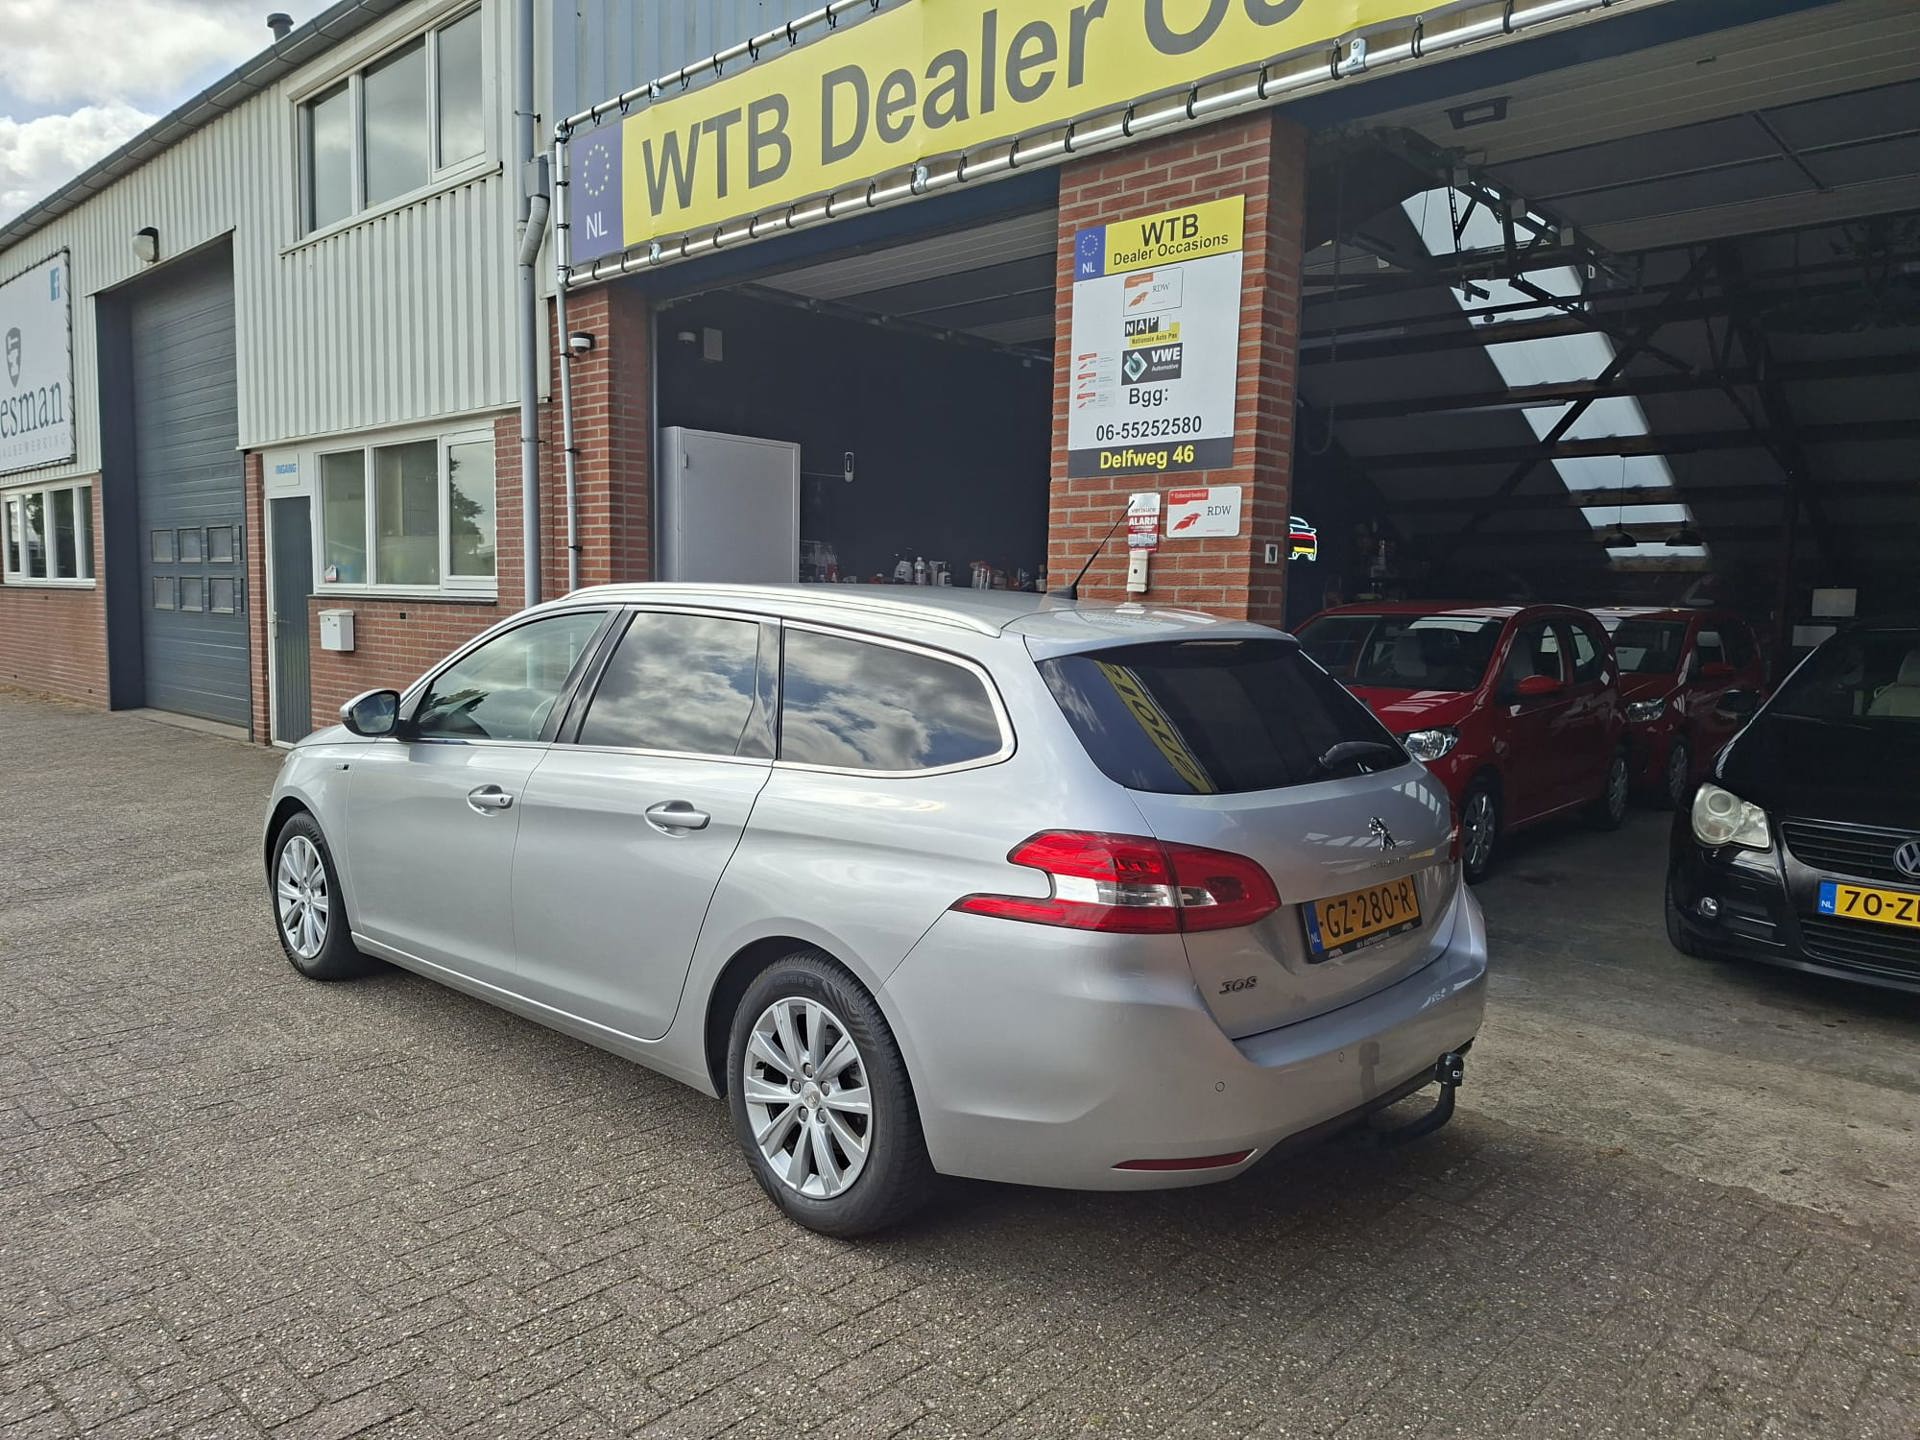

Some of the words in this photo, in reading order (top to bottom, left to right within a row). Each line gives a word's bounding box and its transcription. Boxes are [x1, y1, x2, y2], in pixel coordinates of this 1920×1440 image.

[642, 93, 792, 217] WTB
[822, 0, 1108, 165] Dealer
[585, 210, 608, 241] NL
[1141, 213, 1199, 247] WTB
[1113, 248, 1154, 266] Dealer
[1157, 233, 1229, 257] Occasions
[1082, 261, 1096, 274] NL
[1126, 316, 1157, 335] NAP
[1151, 347, 1181, 363] VWE
[1128, 387, 1169, 408] Bgg:
[1096, 415, 1202, 442] 06-55252580
[1100, 448, 1168, 470] Delfweg
[1172, 444, 1195, 464] 46
[1128, 516, 1158, 526] ALARM
[1207, 505, 1232, 516] RDW
[1821, 900, 1833, 909] NL
